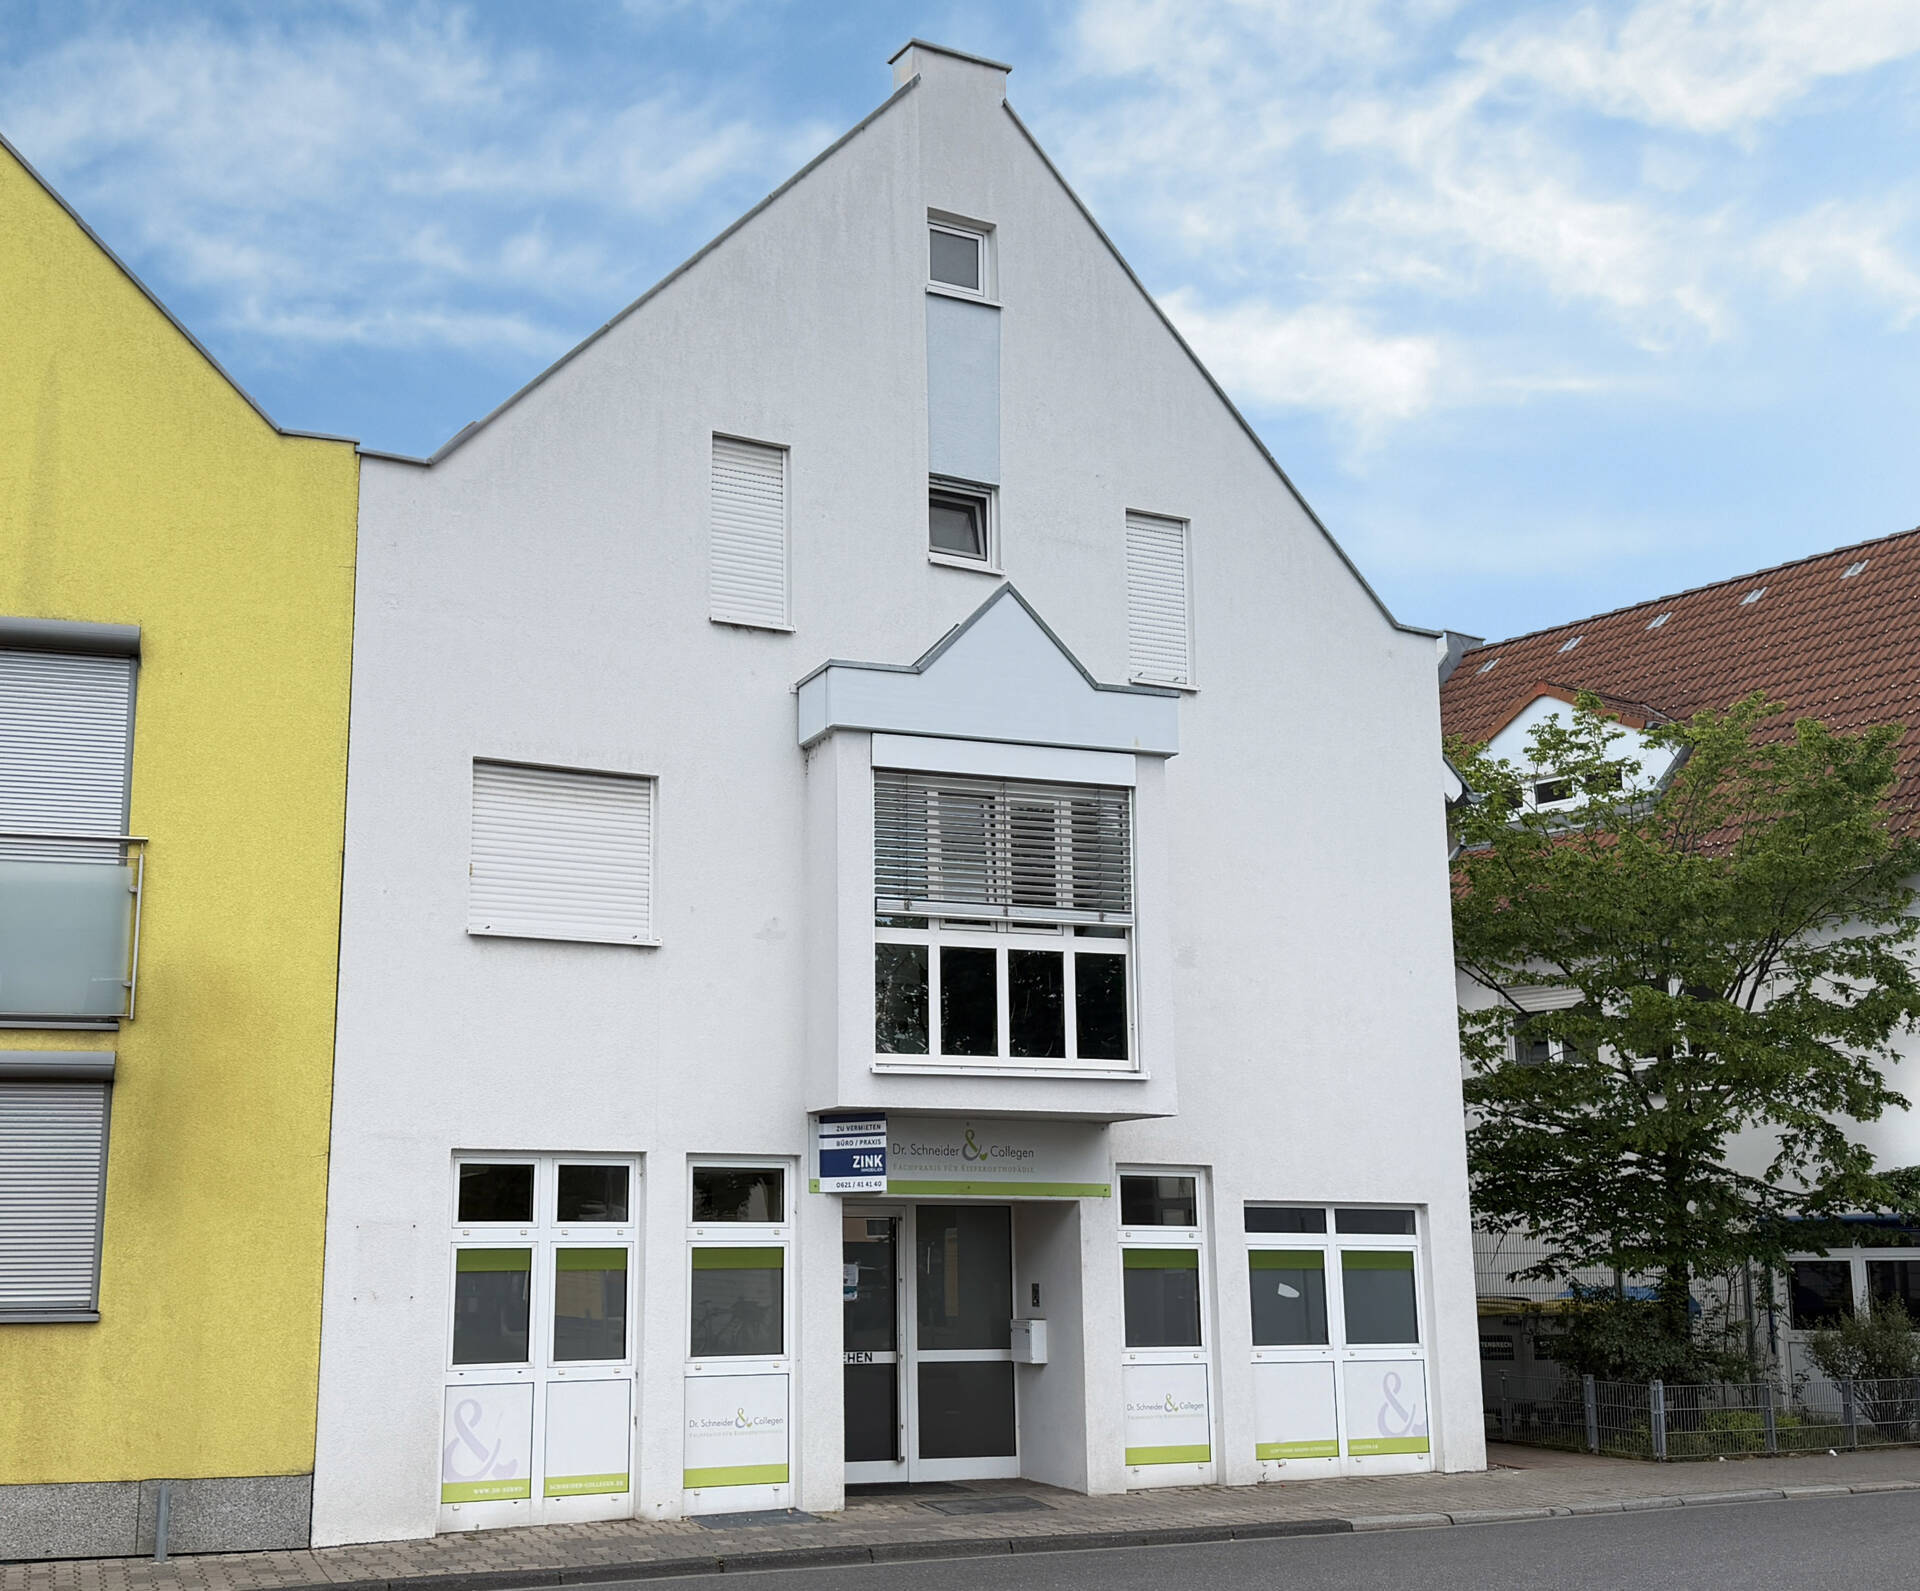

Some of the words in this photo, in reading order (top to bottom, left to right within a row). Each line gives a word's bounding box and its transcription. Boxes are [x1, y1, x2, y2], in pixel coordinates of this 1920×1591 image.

[892, 1142, 907, 1155] Dr.
[910, 1143, 961, 1156] Schneider
[990, 1145, 1035, 1160] Collegen
[852, 1154, 883, 1168] ZINK
[1136, 1403, 1163, 1411] Schneider
[1179, 1402, 1205, 1411] Collegen
[701, 1418, 734, 1428] Schneider
[754, 1416, 784, 1426] Collegen
